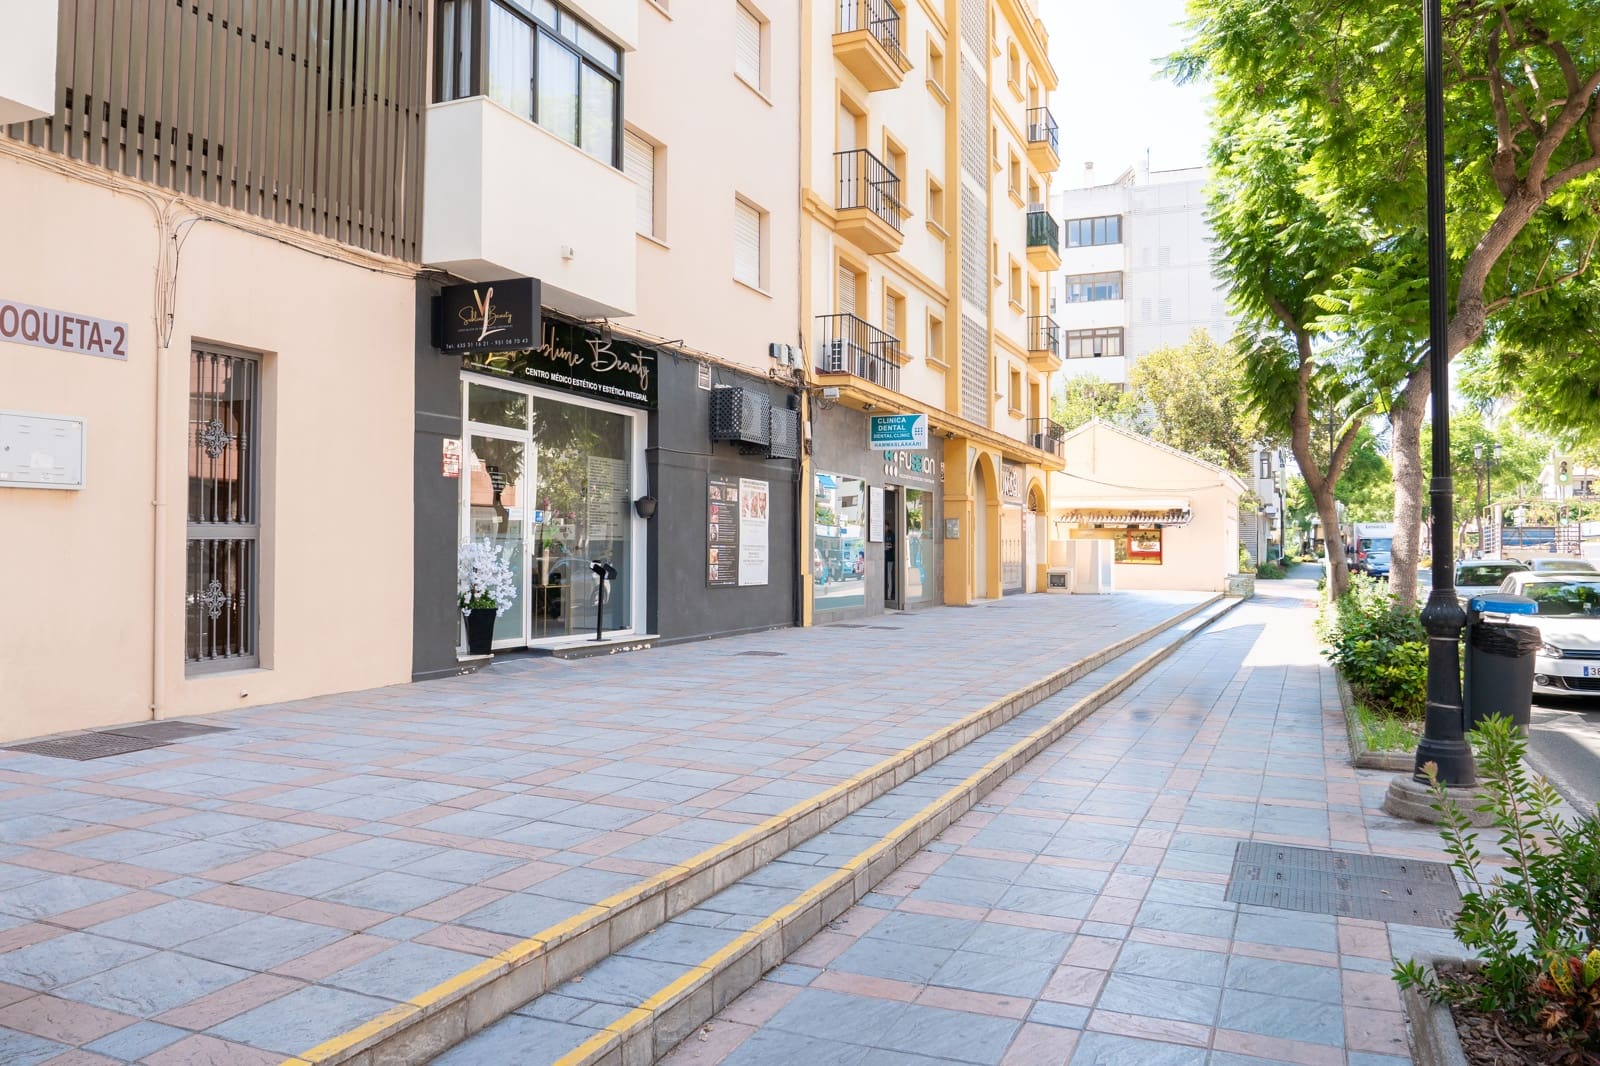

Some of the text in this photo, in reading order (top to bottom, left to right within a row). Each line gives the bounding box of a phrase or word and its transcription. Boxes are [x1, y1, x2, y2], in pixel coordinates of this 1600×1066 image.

[0, 304, 126, 356] OQUETA-2
[525, 367, 550, 380] CENTRO
[550, 372, 573, 385] MÉDICO
[572, 378, 598, 391] ESTÉTICO
[598, 384, 603, 392] Y
[602, 385, 626, 397] ESTÉTICA
[625, 390, 649, 402] INTEGRAL
[585, 338, 655, 391] Beauty
